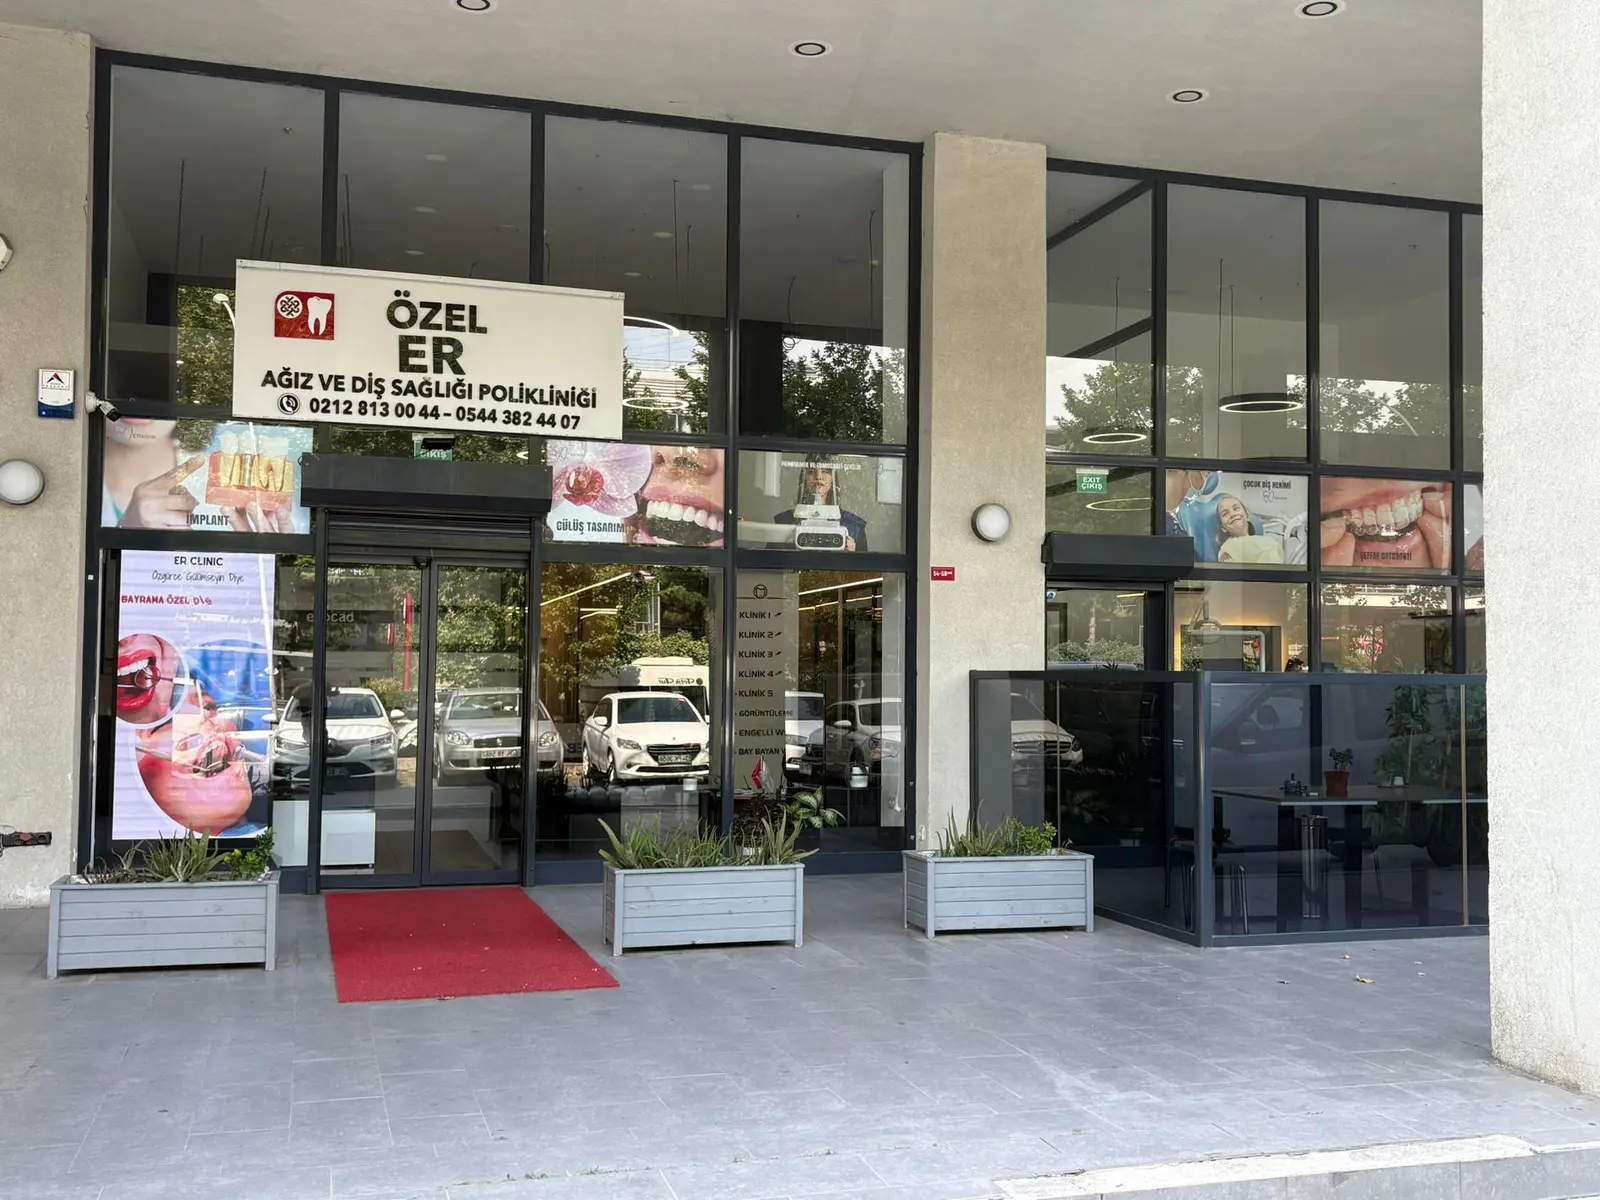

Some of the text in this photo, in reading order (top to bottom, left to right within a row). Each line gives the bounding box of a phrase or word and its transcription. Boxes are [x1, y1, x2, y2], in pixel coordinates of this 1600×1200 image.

[387, 289, 488, 334] ÖZEL
[399, 335, 466, 375] ER
[261, 366, 598, 409] AĞIZ VE DİŞ SAĞLIĞI POLİKLİNİĞİ
[309, 397, 353, 415] 0212
[357, 400, 390, 418] 813
[394, 403, 416, 419] 00
[418, 404, 441, 421] 44
[456, 406, 498, 424] 0544
[502, 409, 533, 427] 382
[536, 413, 557, 429] 44
[560, 414, 581, 430] 07
[1081, 482, 1103, 491] ÇIKIŞ
[1243, 480, 1261, 489] ÇOCUK
[556, 518, 584, 534] GÜLÜŞ
[174, 556, 224, 567] ER CLINIC
[121, 594, 164, 605] BAYRAMA
[166, 593, 190, 605] ÖZEL
[739, 610, 766, 619] KLİNİK
[738, 629, 766, 638] KLİNİK
[738, 649, 766, 658] KLİNİK
[738, 669, 774, 678] KLİNİK 4
[738, 689, 766, 697] KLİNİK
[739, 727, 774, 736] ENGELLİ
[738, 747, 754, 755] BAY
[755, 747, 780, 755] BAYAN
